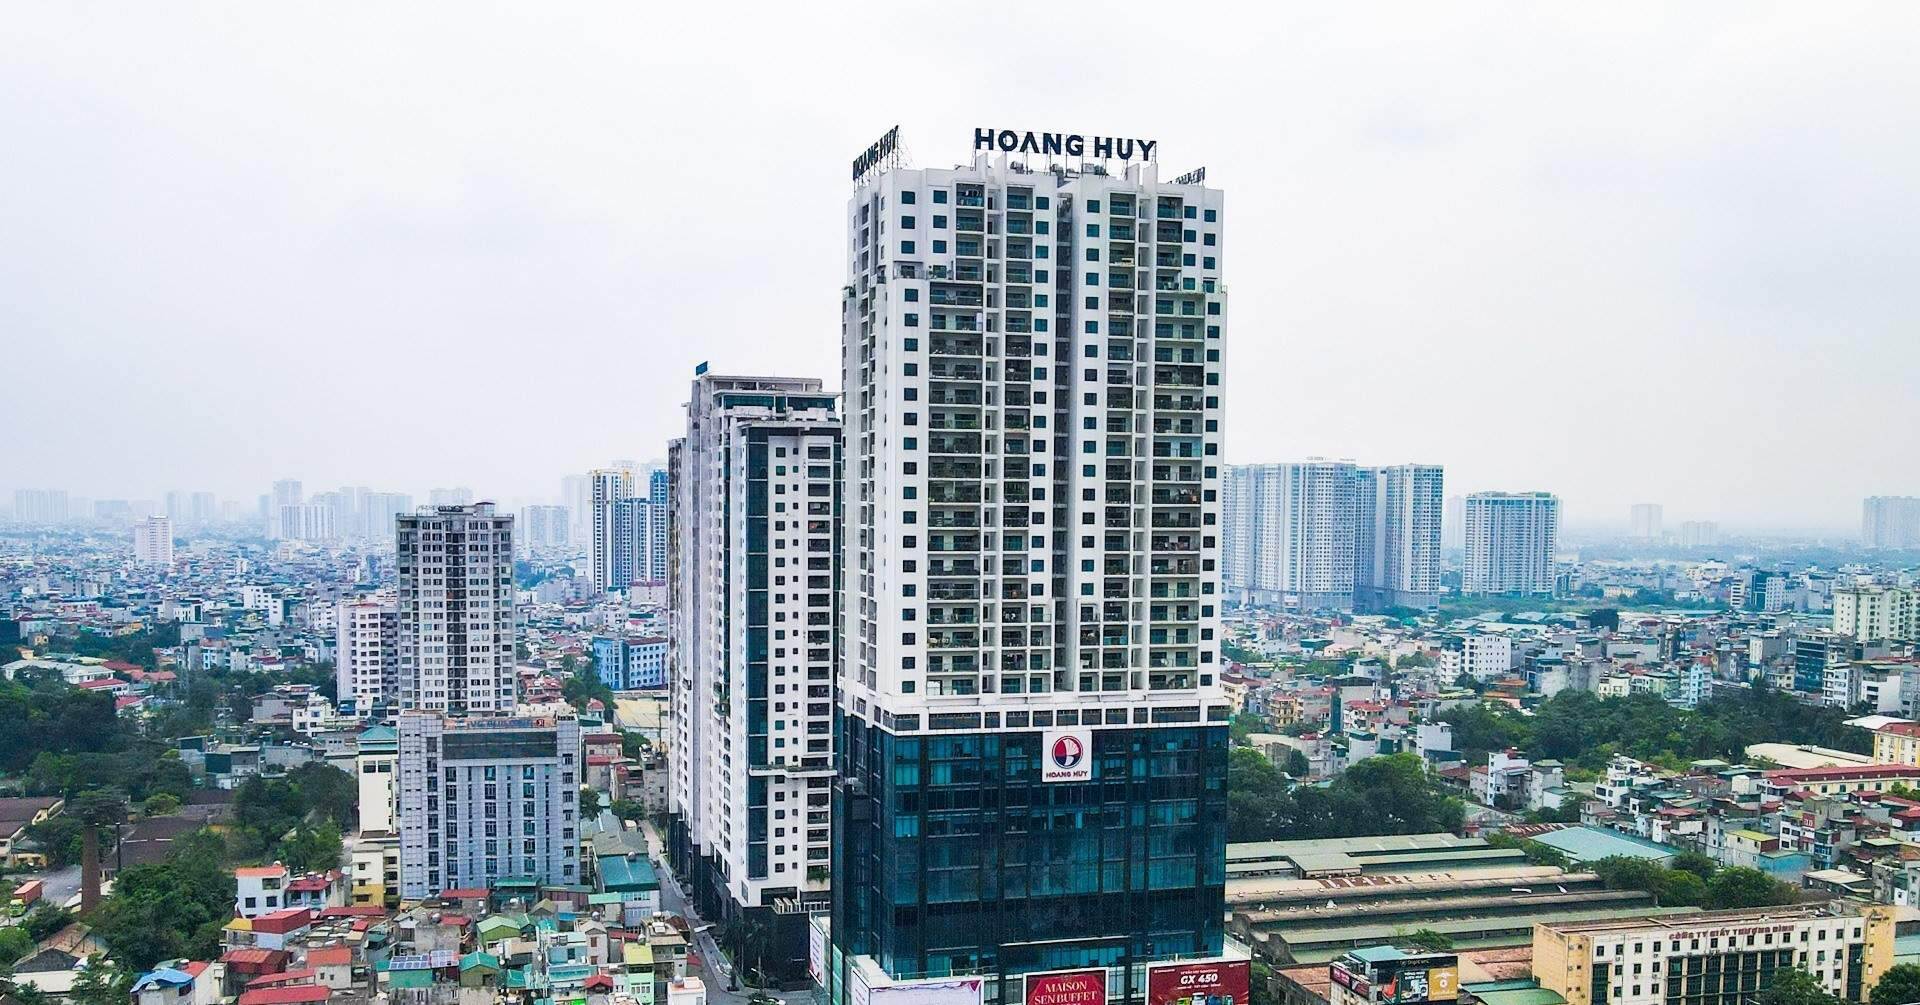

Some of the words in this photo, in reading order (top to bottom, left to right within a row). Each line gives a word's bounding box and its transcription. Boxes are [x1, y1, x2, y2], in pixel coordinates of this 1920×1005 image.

[975, 128, 1084, 157] HOANG
[1094, 136, 1157, 161] HUY
[1696, 930, 1708, 938] TY
[1180, 975, 1196, 985] GX
[1197, 973, 1219, 983] 450
[1045, 981, 1087, 993] MAISON
